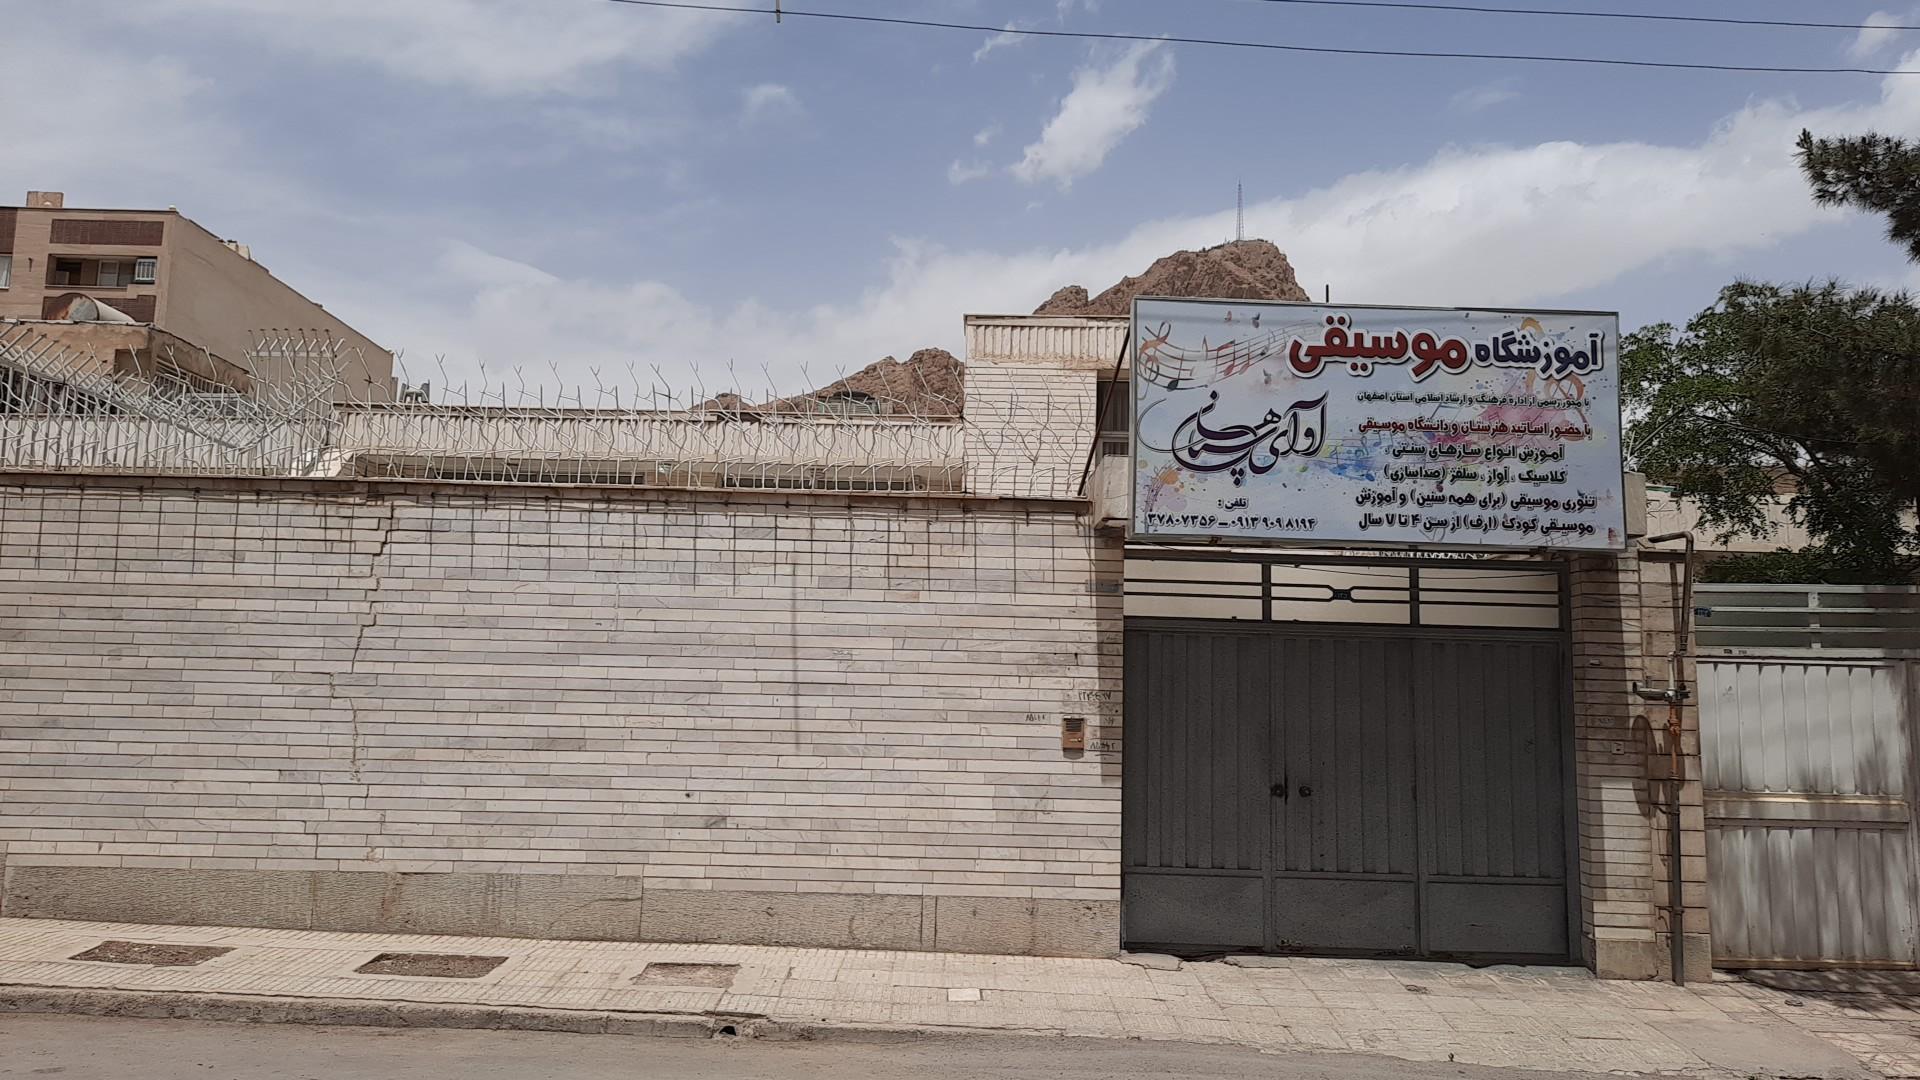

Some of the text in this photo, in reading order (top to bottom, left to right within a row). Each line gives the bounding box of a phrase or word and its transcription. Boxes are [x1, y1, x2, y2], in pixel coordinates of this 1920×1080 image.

[1290, 315, 1601, 377] آموزشگاه موسیقی
[1357, 391, 1388, 402] اصفهان
[1389, 392, 1413, 402] استان
[1414, 393, 1444, 405] اسلامی
[1445, 393, 1466, 405] ارشاد
[1475, 394, 1507, 406] فرهنگ
[1509, 396, 1527, 406] اداره
[1527, 396, 1535, 407] از
[1537, 398, 1561, 408] رسمی
[1584, 399, 1590, 407] با
[1358, 416, 1591, 439] با حضور اساتید هنرستان و دانشگاه موسیقی
[1393, 443, 1426, 458] سنتی
[1429, 443, 1481, 460] سازهای
[1484, 445, 1515, 460] انواع
[1518, 444, 1564, 462] آموزش
[1384, 464, 1446, 481] (صداسازی)
[1487, 466, 1509, 484] آواز
[1518, 469, 1567, 486] کلاسیک
[1224, 498, 1247, 509] تلفن
[1355, 488, 1397, 507] آموزش
[1399, 493, 1406, 506] و
[1410, 490, 1446, 505] سنین)
[1450, 493, 1476, 505] همه
[1479, 492, 1506, 508] (برای
[1510, 497, 1560, 511] موسیقی
[1359, 513, 1594, 535] موسیقی کودک (ارف) از سن ۴ تا ۷ سال
